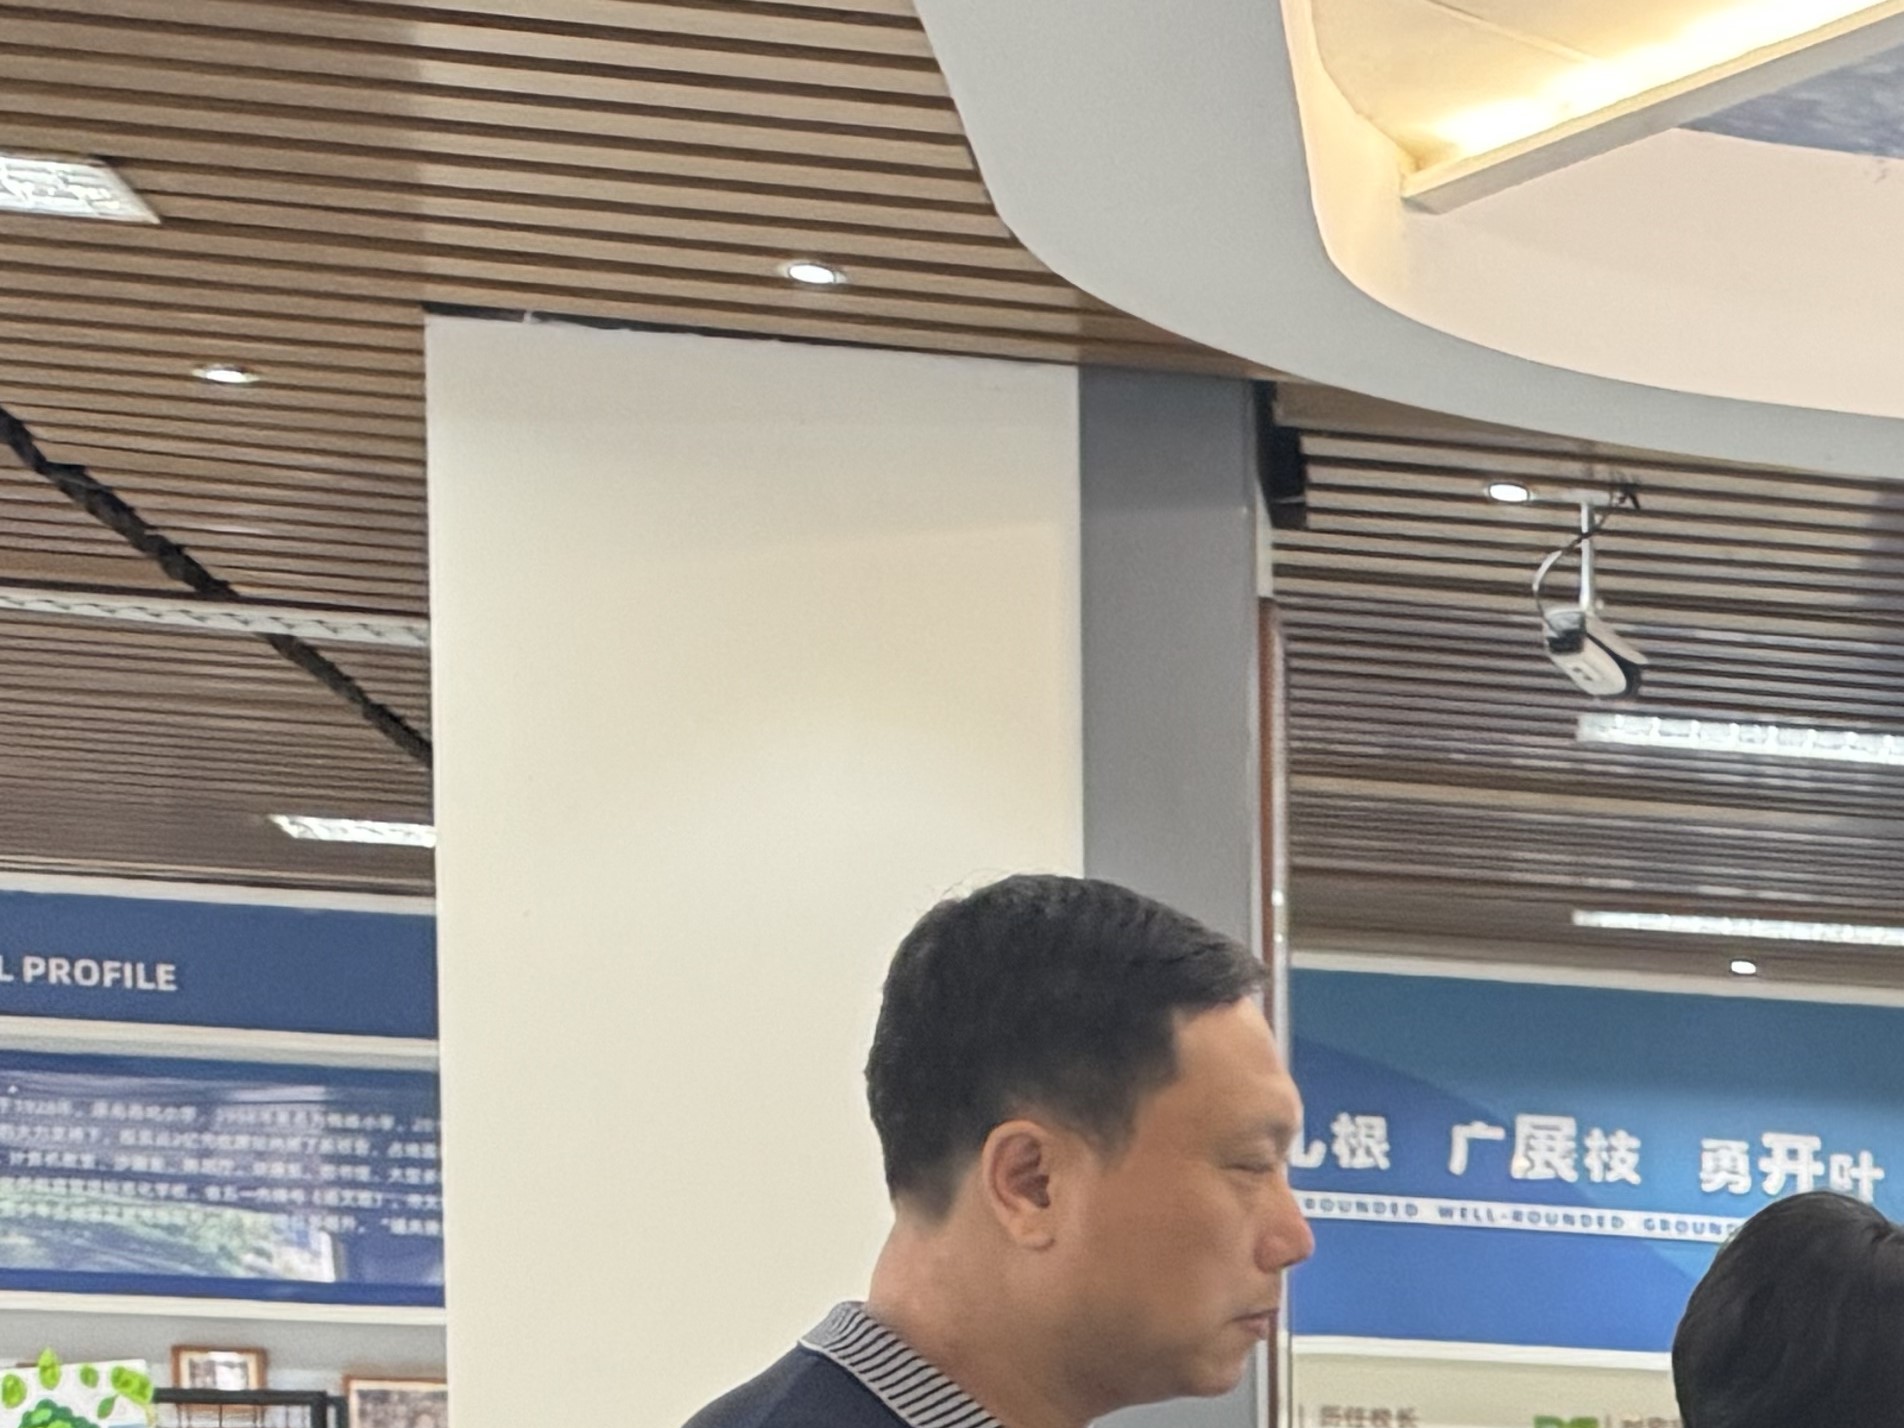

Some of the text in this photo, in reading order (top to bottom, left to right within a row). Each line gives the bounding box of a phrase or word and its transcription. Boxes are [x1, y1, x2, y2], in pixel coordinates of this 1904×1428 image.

[23, 955, 178, 991] PROFILE
[1449, 1114, 1642, 1185] 广展枝
[1699, 1132, 1885, 1206] 勇开叶
[1303, 1198, 1419, 1217] ROUNDED
[1437, 1206, 1625, 1229] WELL-ROUNDED
